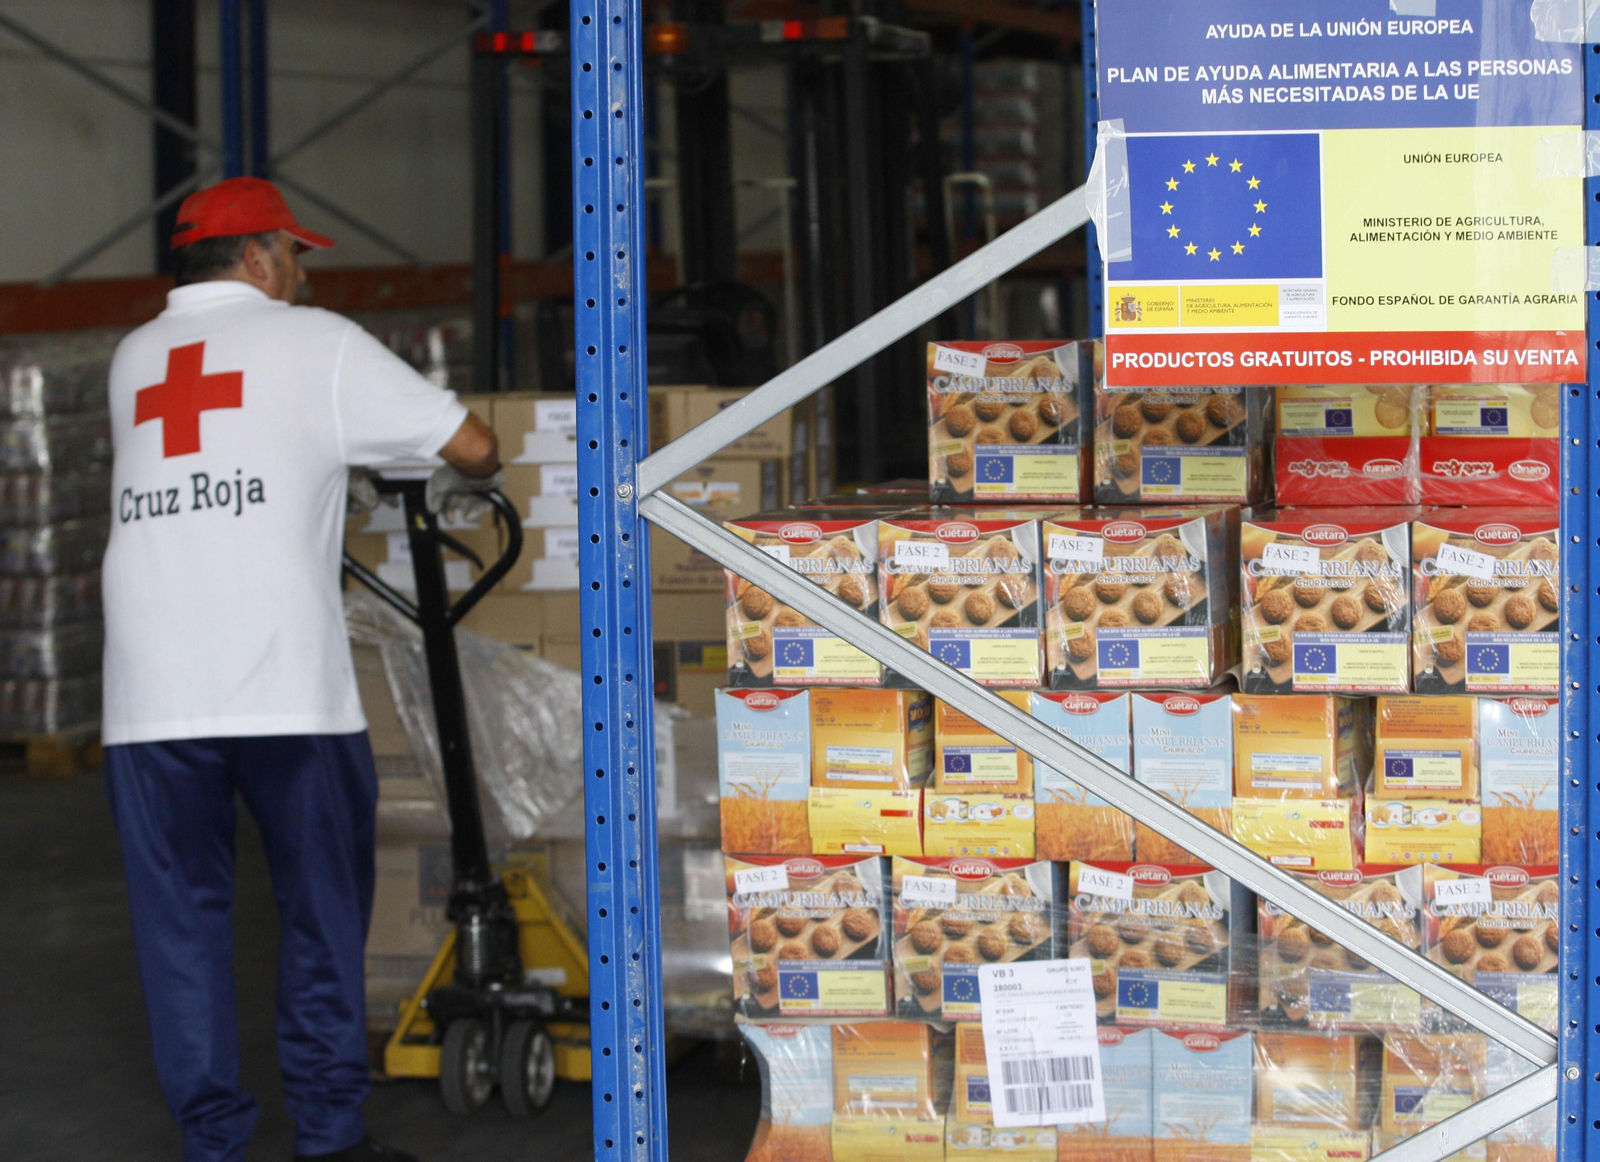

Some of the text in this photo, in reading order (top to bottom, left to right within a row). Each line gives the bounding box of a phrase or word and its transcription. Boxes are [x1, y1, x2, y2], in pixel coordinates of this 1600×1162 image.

[1206, 19, 1473, 38] AYUDA DE LA UNIÓN EUROPEA
[1107, 58, 1572, 83] PLAN DE AYUDA ALIMENTARIA A LAS PERSONAS
[1202, 84, 1479, 104] MÁS NECESITADAS DE LA UE
[1403, 151, 1502, 163] UNIÓN EUROPEA
[1363, 216, 1543, 228] MINISTERIO DE AGRICULTURA,
[1349, 229, 1557, 242] ALIMENTACIÓN Y MEDIO AMBIENTE
[1332, 292, 1577, 305] FONDO ESPAÑOL DE GARANTÍA AGRARIA
[937, 351, 977, 368] FASE 2
[1112, 351, 1234, 368] PRODUCTOS
[1240, 350, 1352, 366] GRATUITOS
[1370, 350, 1477, 366] PROHIBIDA
[1483, 349, 1508, 365] SU
[1514, 349, 1578, 365] VENTA
[934, 377, 1073, 392] CAMPURRIANAS
[119, 469, 266, 523] Cruz Roja
[781, 529, 819, 538] Cuétara
[938, 528, 976, 538] Cuétara
[1103, 527, 1143, 537] Cuétara
[1304, 530, 1344, 540] Cuétara
[1477, 530, 1518, 539] Cuétara
[1051, 538, 1093, 552] FASE 2
[898, 545, 940, 558] FASE 2
[1265, 547, 1309, 562] FASE 2
[1441, 548, 1485, 568] FASE 2
[791, 557, 874, 573] RRIANAS
[1050, 556, 1201, 573] CAMPURRIANAS
[1421, 558, 1559, 577] CRRIAN
[1097, 575, 1154, 583] CHURRUSCOS
[1295, 578, 1355, 587] CHURRUSCOS
[746, 696, 778, 706] Cuétara
[1064, 700, 1098, 710] Cuétara
[1165, 701, 1199, 711] Cuétara
[1512, 701, 1547, 711] Cuétara
[1067, 736, 1124, 745] RRIANAS
[1487, 736, 1559, 747] CAMPURRIAN
[952, 864, 990, 874] Cuétara
[1128, 870, 1168, 880] Cuétara
[737, 870, 777, 884] FASE 2
[1081, 872, 1124, 890] FASE 2
[1320, 871, 1359, 881] Cuétara
[1487, 872, 1526, 882] Cuétara
[940, 883, 946, 892] 2
[1437, 883, 1481, 896] FASE 2
[1075, 894, 1224, 919] CAMPURRIANAS
[1266, 900, 1416, 918] CRIANAS
[1431, 900, 1558, 918] CAMPURRIAN
[992, 970, 1006, 978] VB
[994, 983, 1022, 992] 280003
[1185, 1037, 1218, 1047] Cuétara
